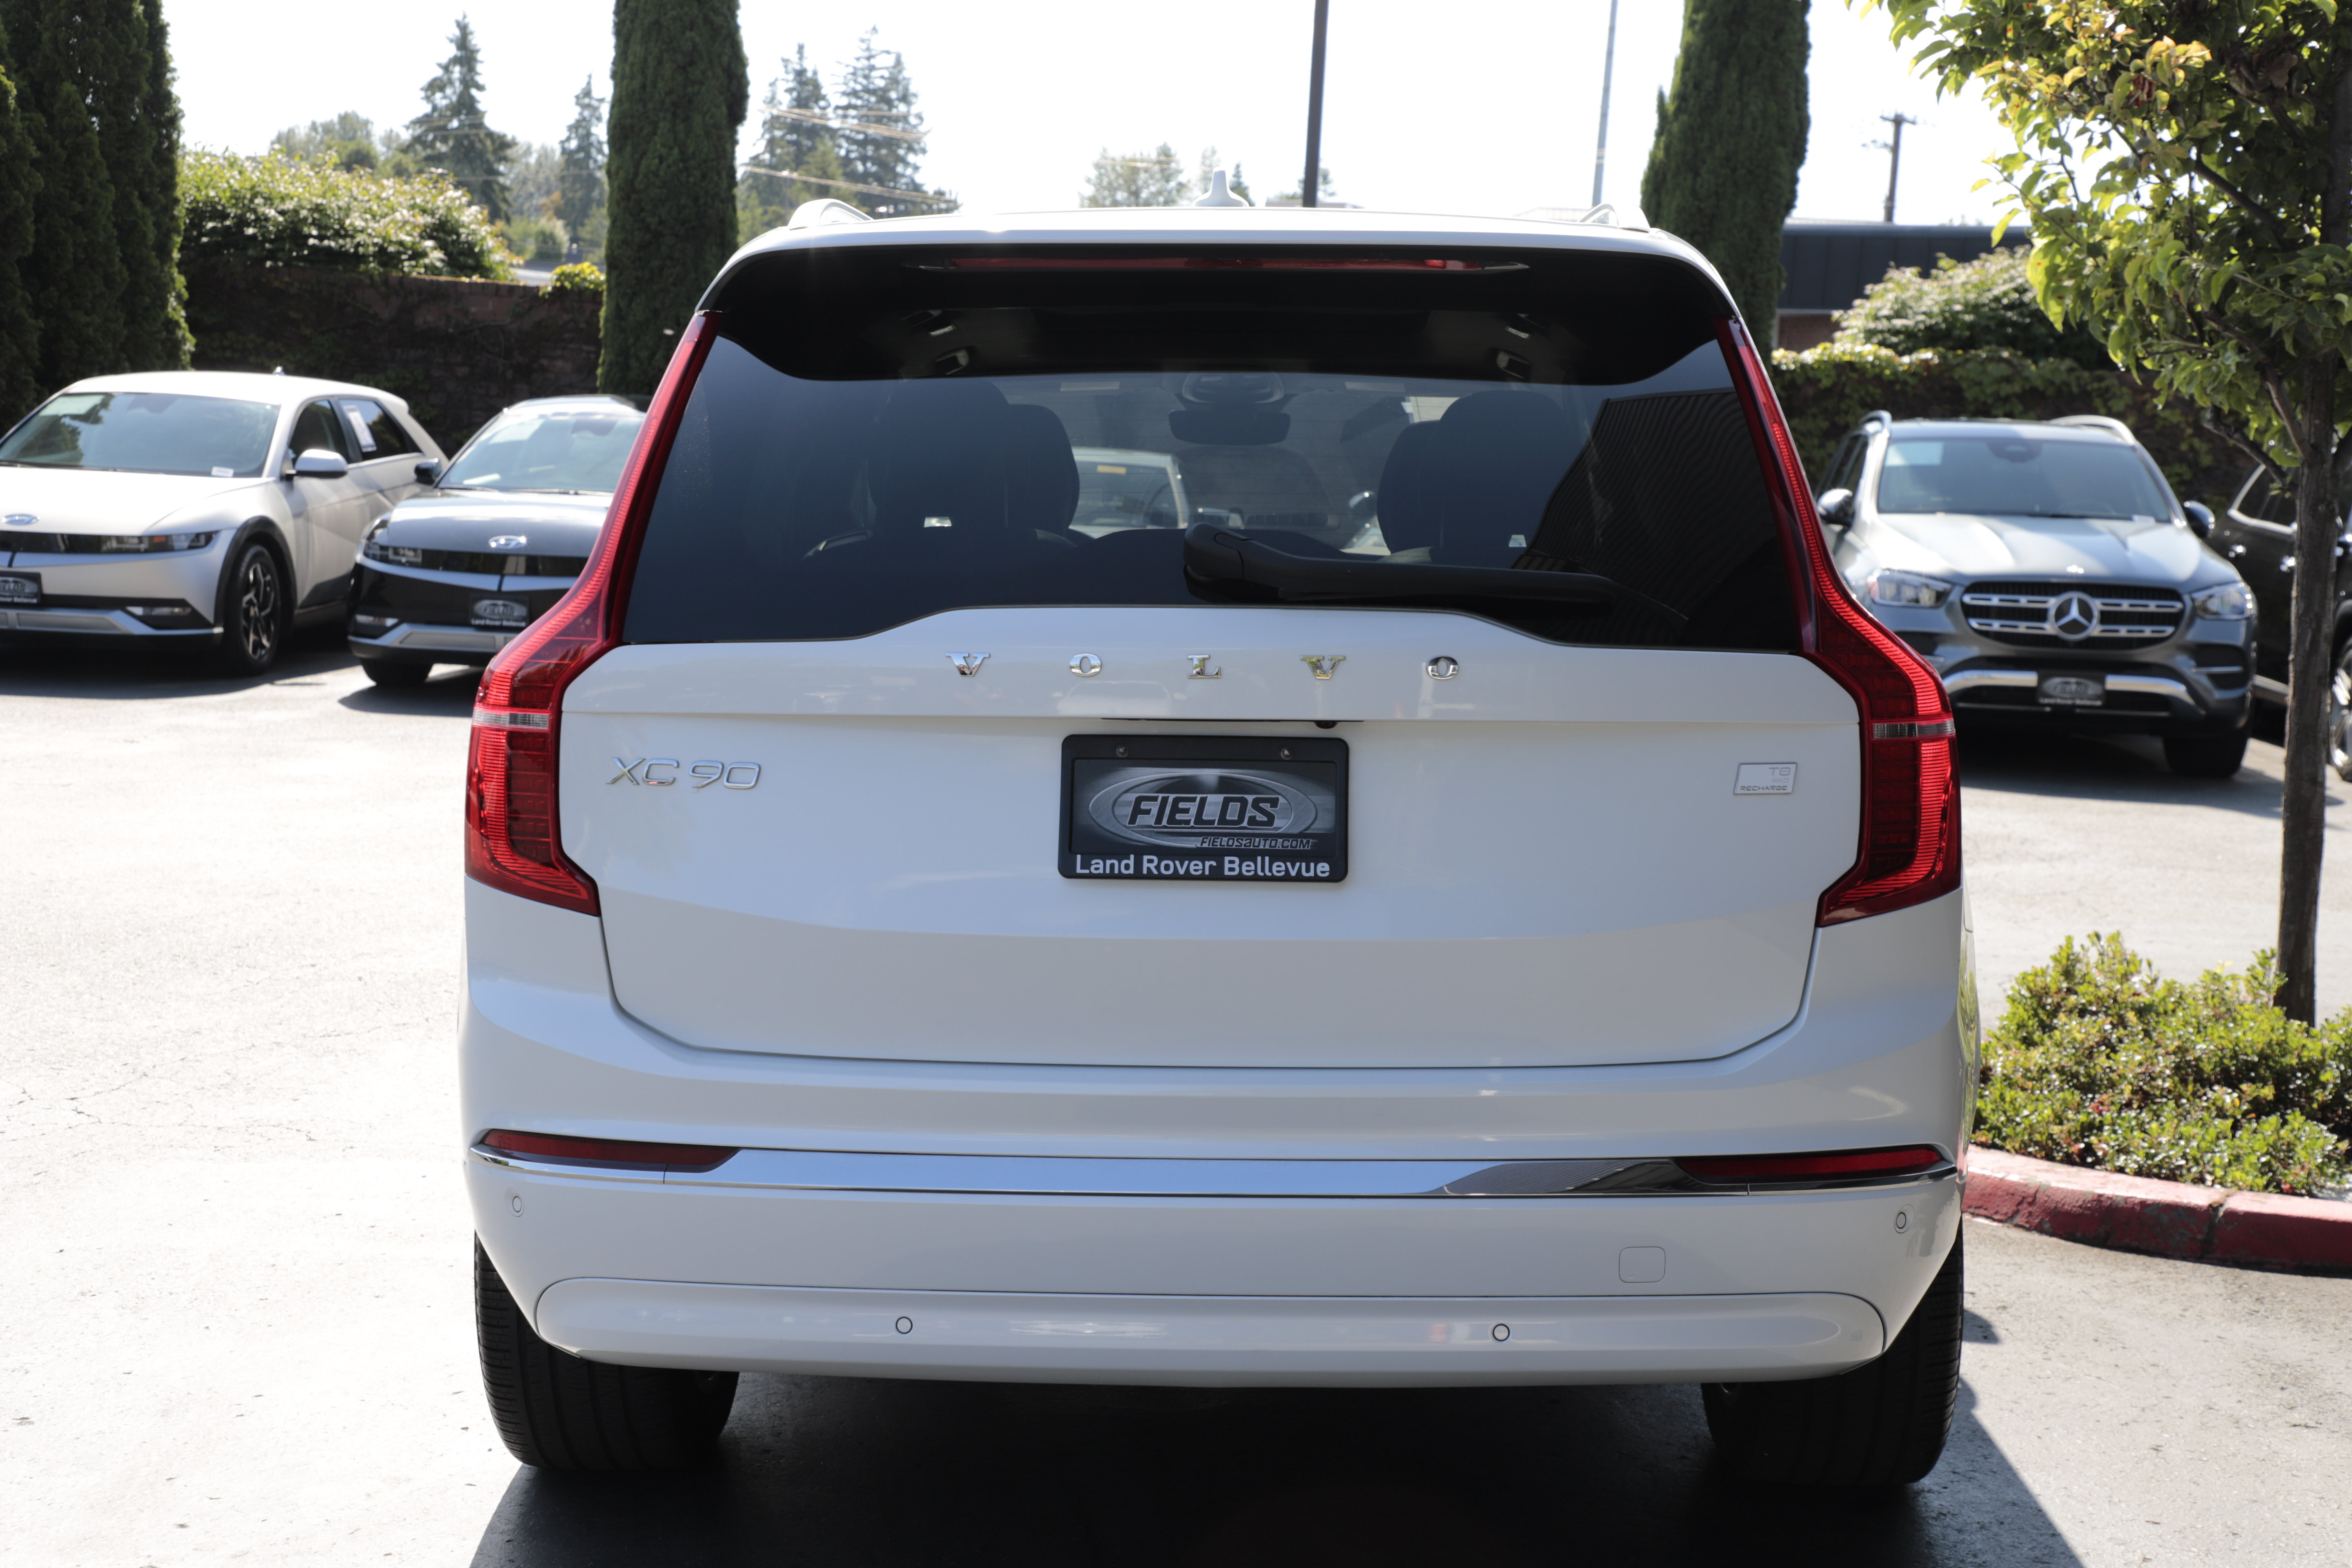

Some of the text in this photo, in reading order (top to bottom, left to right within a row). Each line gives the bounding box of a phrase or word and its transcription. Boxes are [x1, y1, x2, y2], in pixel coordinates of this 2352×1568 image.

[945, 652, 1459, 680] VOLVO
[1769, 767, 1791, 776] T8
[1127, 795, 1281, 828] FIELDS
[1076, 854, 1330, 878] Land Rover Bellevue
